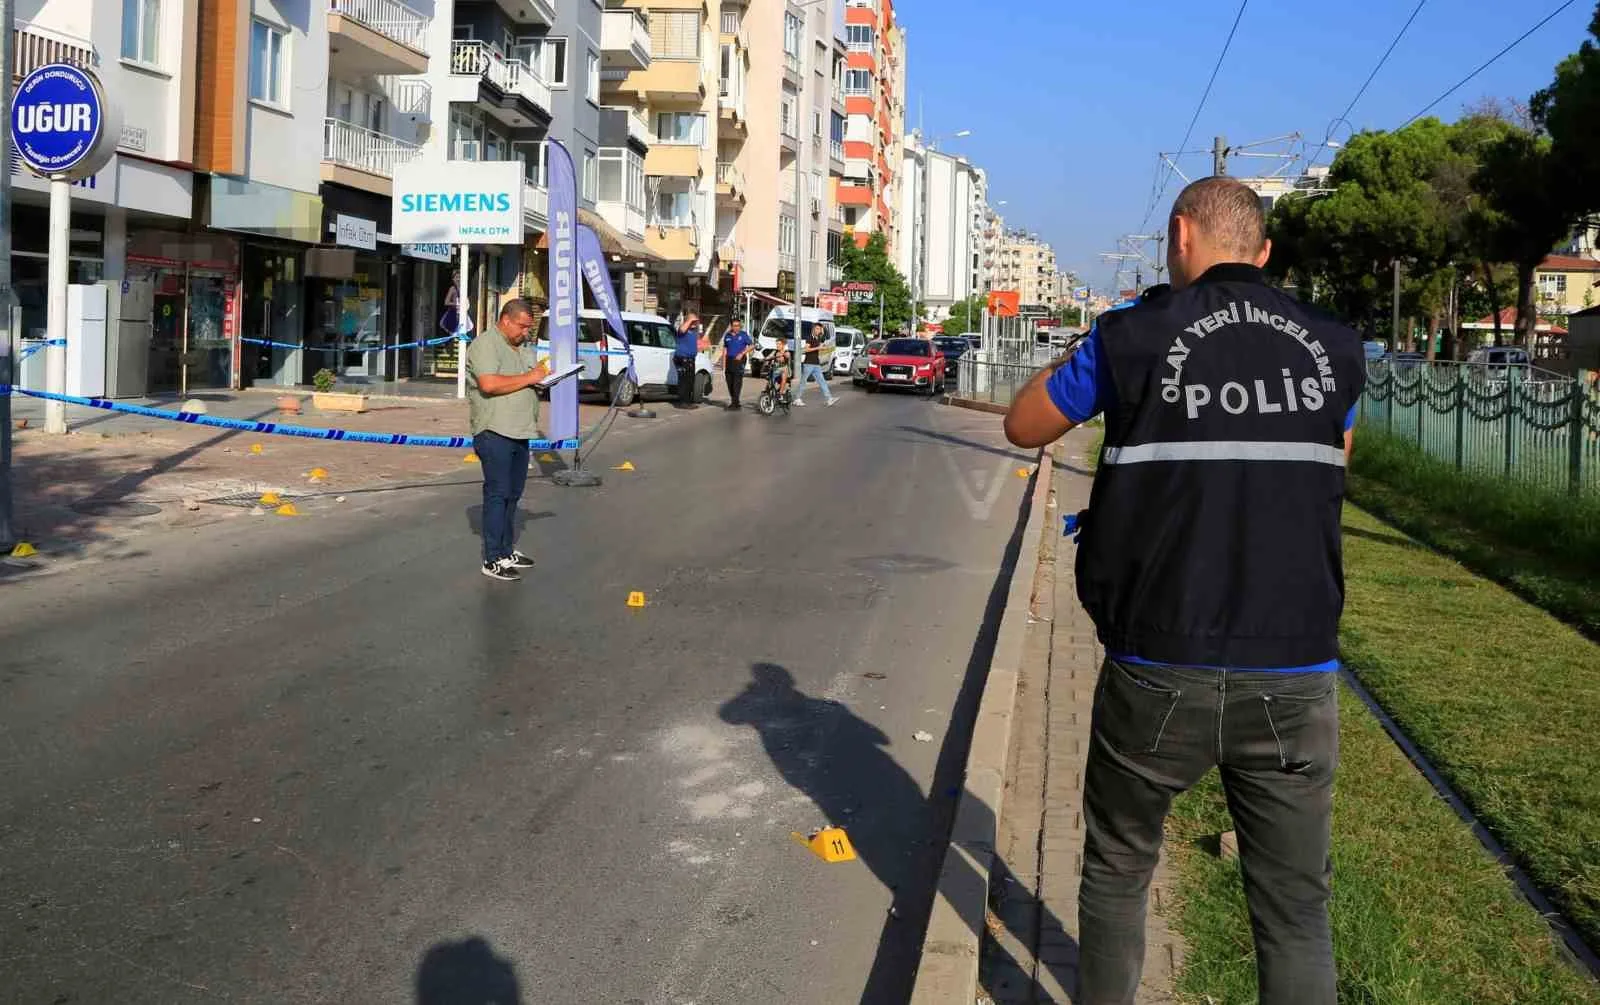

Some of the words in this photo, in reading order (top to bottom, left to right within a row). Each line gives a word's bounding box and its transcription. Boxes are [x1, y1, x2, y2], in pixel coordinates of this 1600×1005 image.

[17, 101, 92, 133] UĞUR
[401, 192, 511, 213] SIEMENS
[1161, 336, 1191, 403] OLAY
[1244, 301, 1337, 393] İNCELEME
[1185, 368, 1325, 419] POLİS
[832, 839, 845, 856] 11
